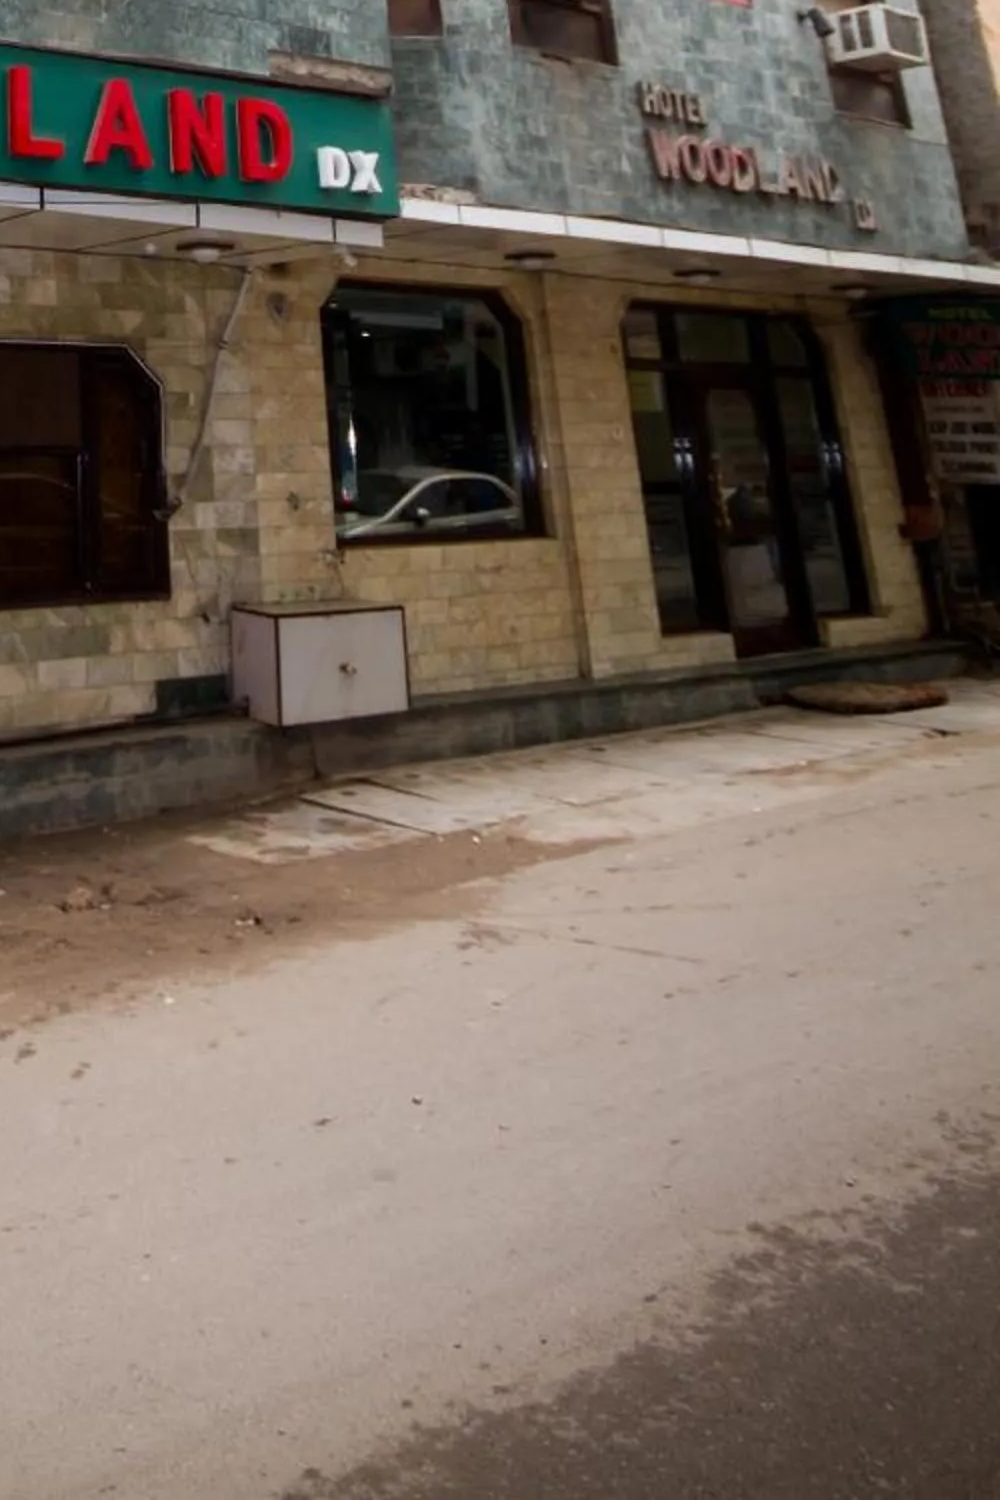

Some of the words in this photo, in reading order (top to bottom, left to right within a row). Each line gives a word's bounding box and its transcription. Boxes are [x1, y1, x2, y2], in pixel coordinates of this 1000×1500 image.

[640, 82, 708, 125] HOTEL
[317, 145, 384, 195] DX
[648, 128, 846, 204] WOODLAND
